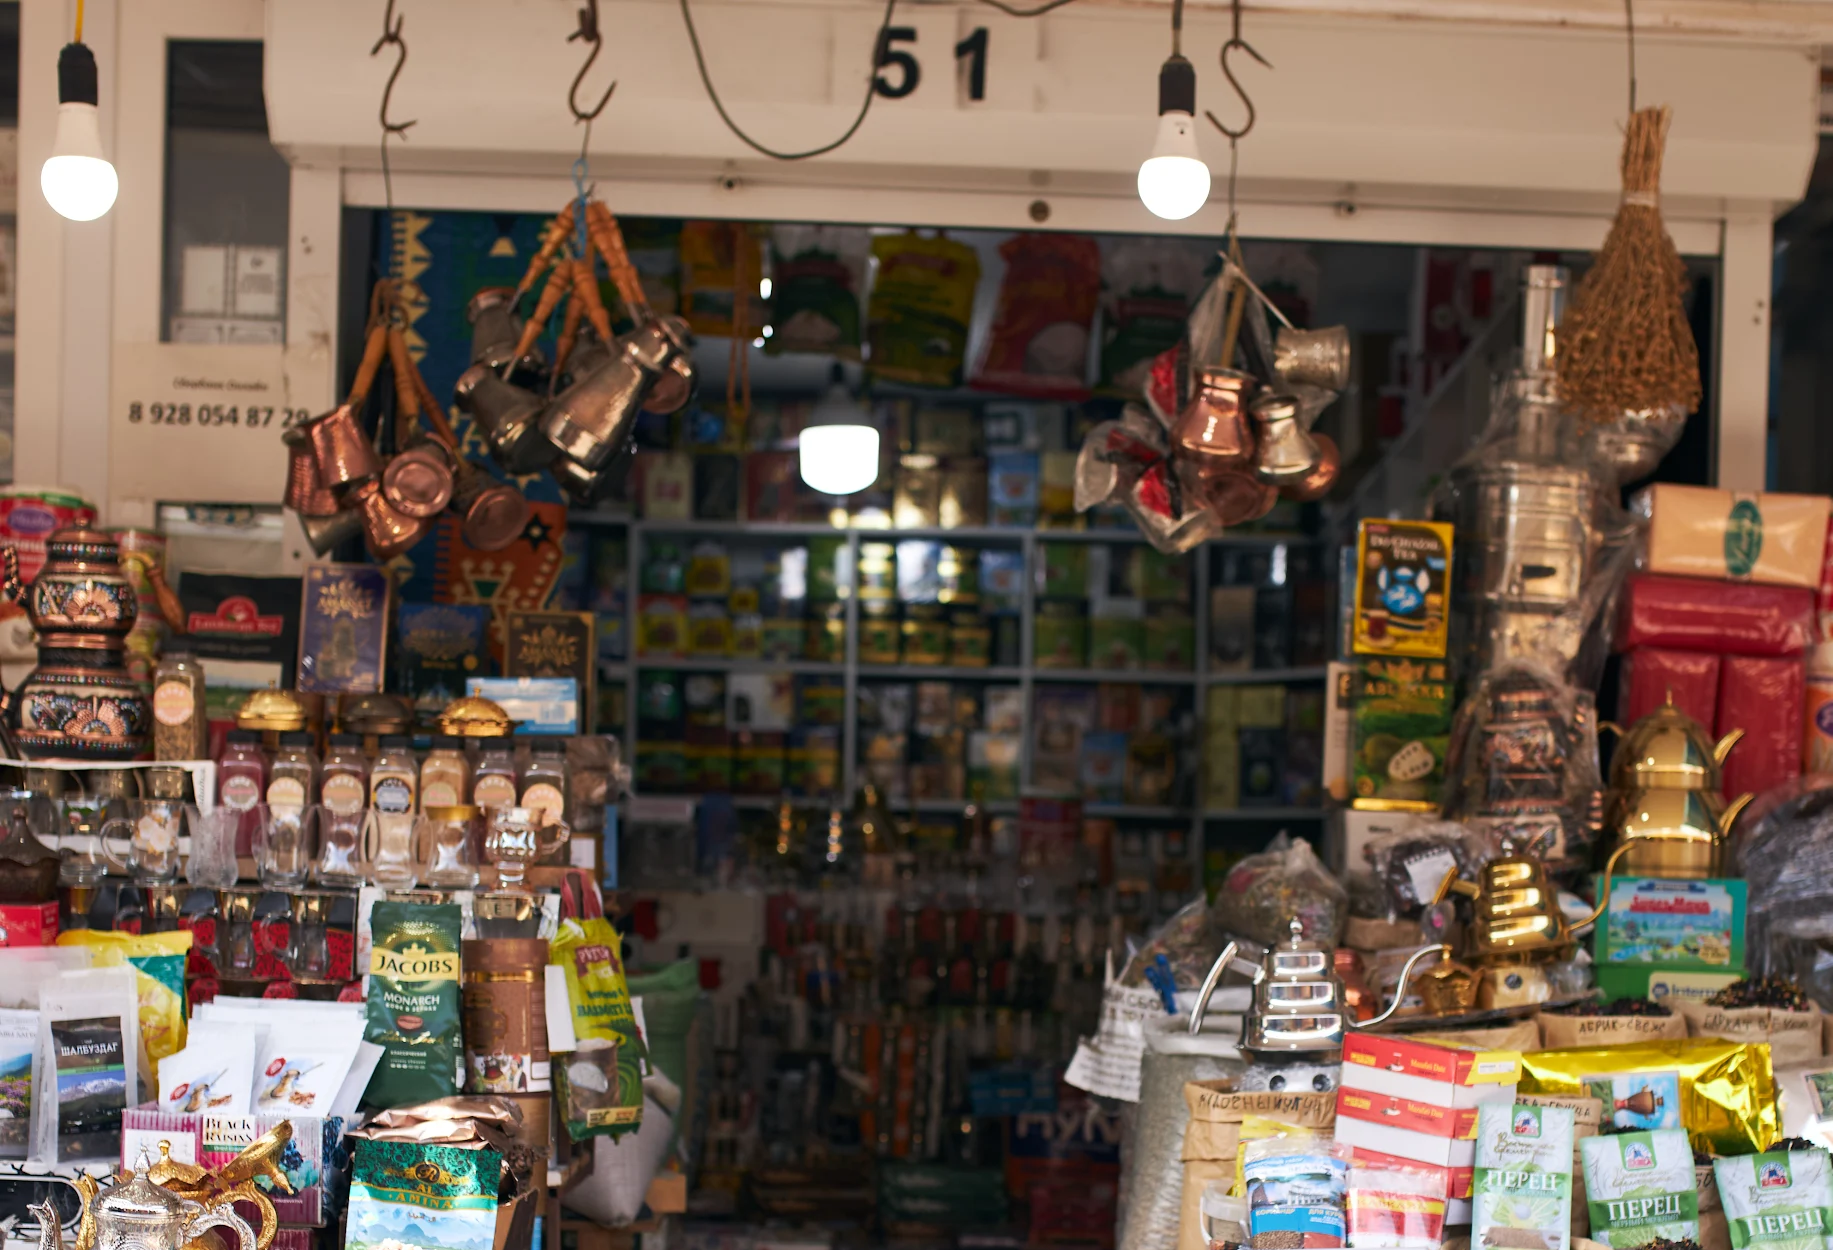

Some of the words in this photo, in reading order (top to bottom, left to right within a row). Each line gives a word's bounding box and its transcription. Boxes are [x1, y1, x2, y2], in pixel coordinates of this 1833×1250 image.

[129, 402, 143, 423] 8
[150, 403, 192, 425] 928
[198, 404, 239, 426] 054
[246, 406, 273, 427] 87
[375, 955, 452, 975] JACOBS
[384, 992, 440, 1006] MONARCH
[206, 1118, 250, 1130] BLACK
[206, 1132, 252, 1142] RAISINS
[1487, 1169, 1557, 1191] ПЕРЕЦ
[417, 1184, 435, 1195] AL
[396, 1193, 453, 1209] AMINA
[1607, 1195, 1681, 1220] ПЕРЕЦ
[1746, 1209, 1824, 1237] ПЕРЕЦ
